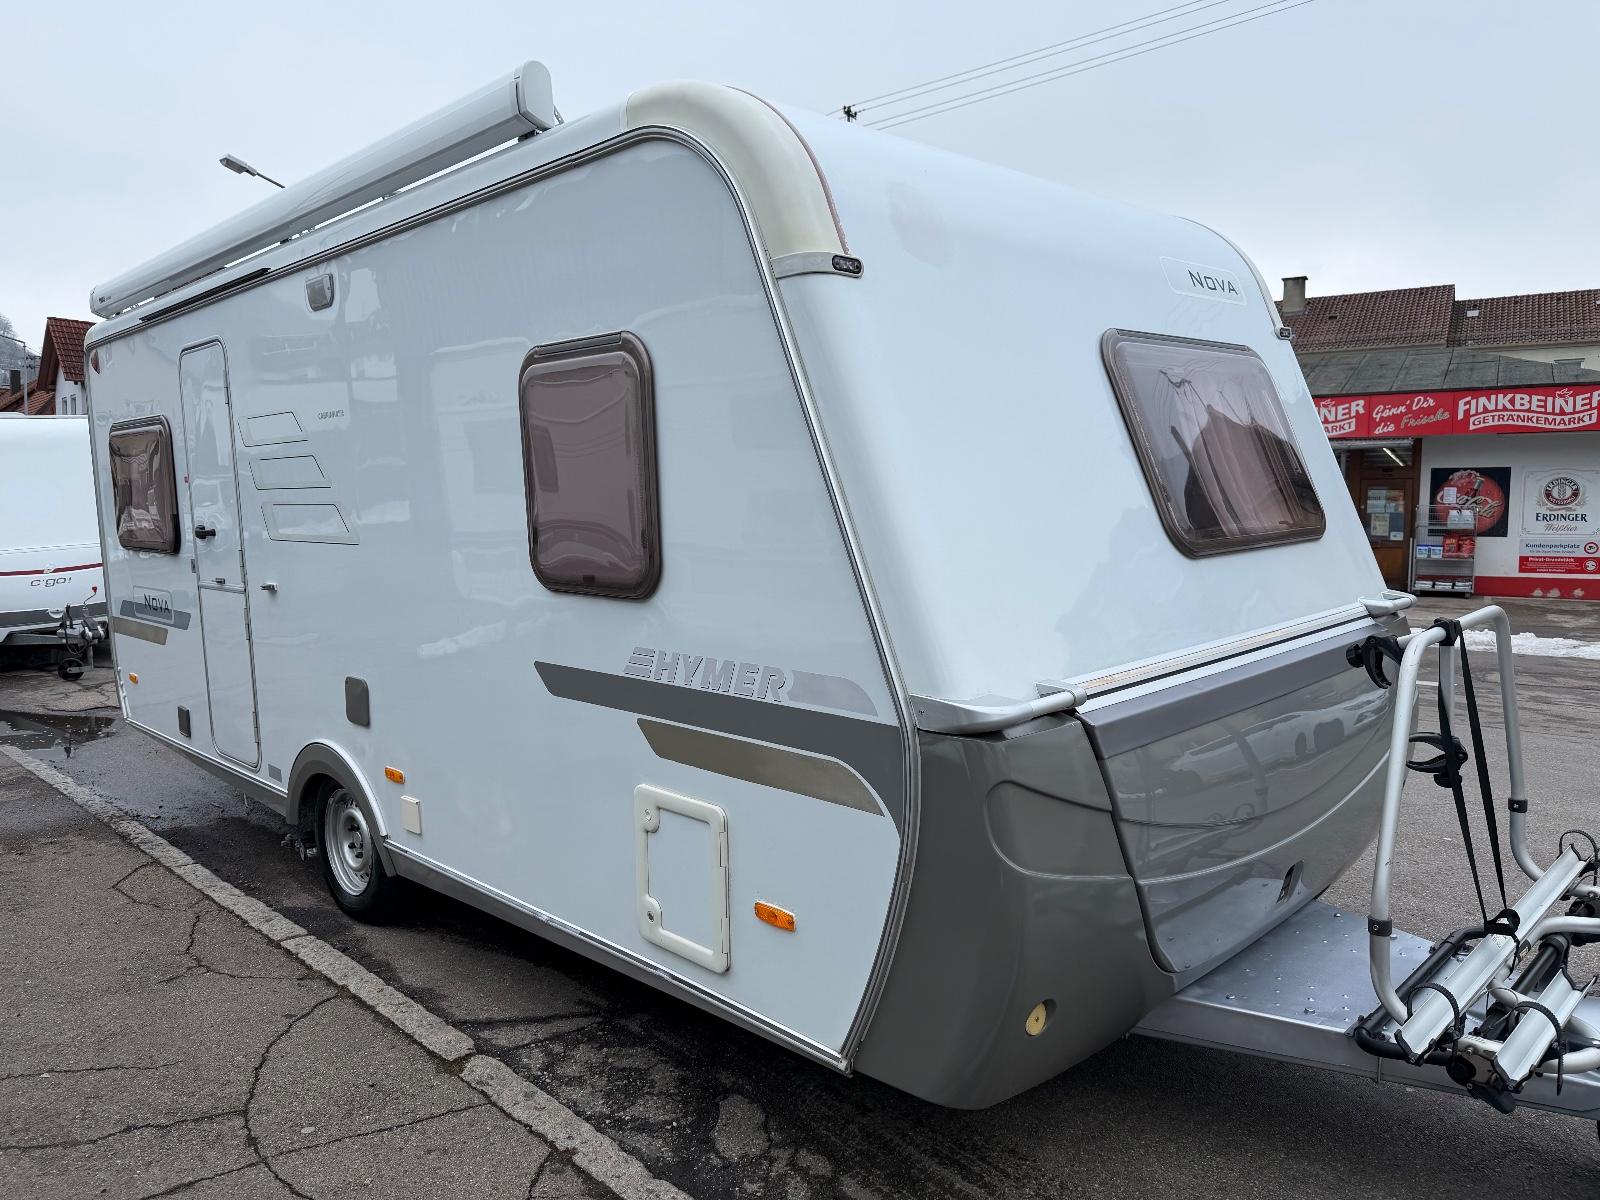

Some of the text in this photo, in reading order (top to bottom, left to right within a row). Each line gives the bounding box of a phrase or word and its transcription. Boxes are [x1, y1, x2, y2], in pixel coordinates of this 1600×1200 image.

[1188, 269, 1239, 296] NOVA
[1412, 396, 1436, 410] Dir
[1374, 407, 1450, 435] die Frische
[1471, 412, 1595, 427] GETRÄNKEMARKT
[1535, 512, 1588, 523] ERDINGER
[1525, 542, 1581, 550] Kundenparkplatz
[143, 593, 171, 614] NOVA
[653, 649, 787, 703] HYMER
